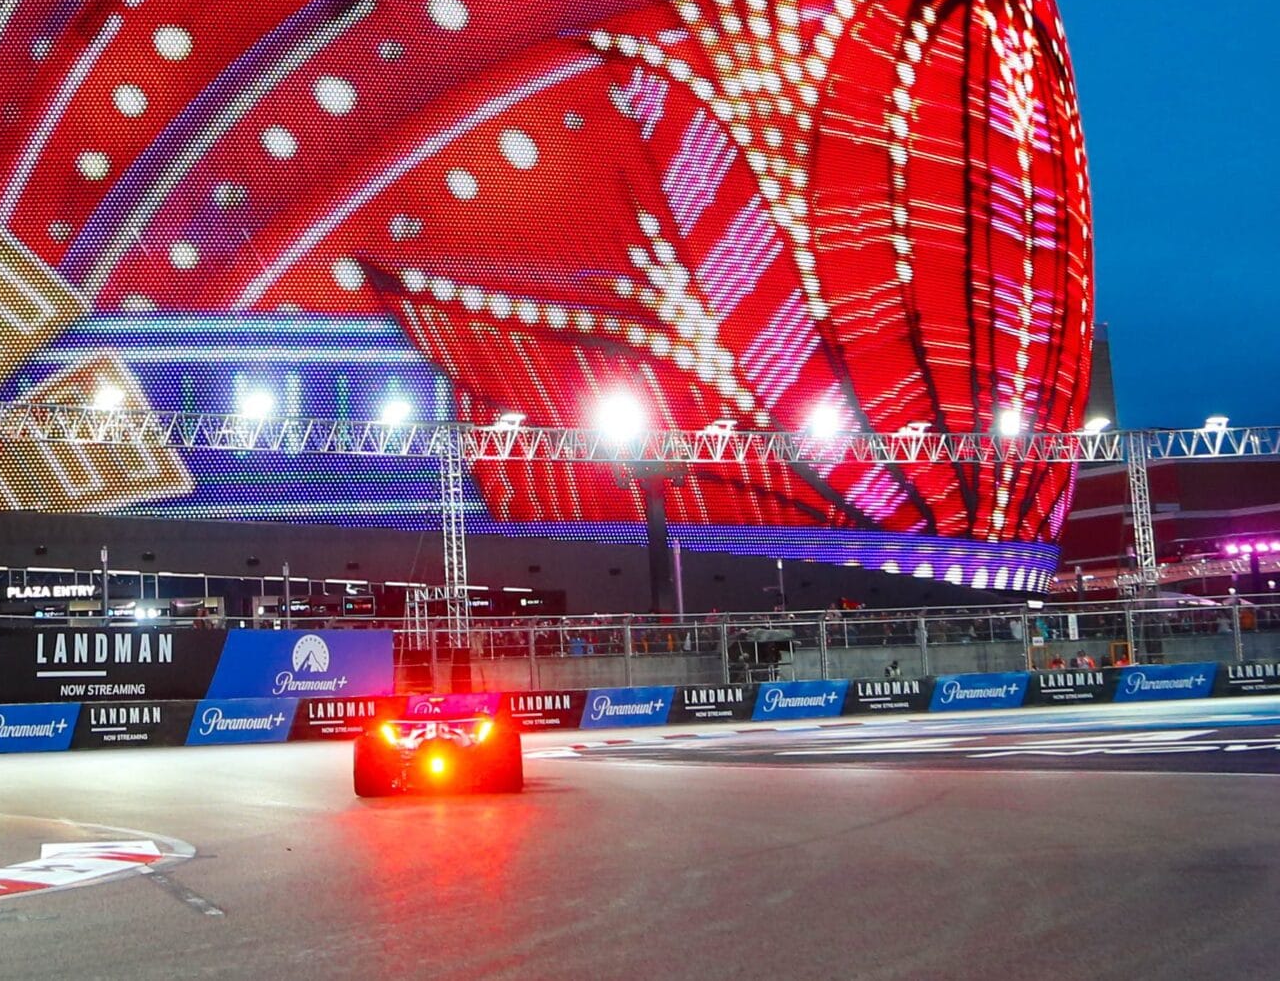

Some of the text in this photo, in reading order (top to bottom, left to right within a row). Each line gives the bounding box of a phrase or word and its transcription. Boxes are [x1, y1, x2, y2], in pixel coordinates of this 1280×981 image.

[7, 585, 95, 598] PLAZA ENTRY
[37, 633, 172, 664] LANDMAN
[272, 671, 348, 695] Paramount+
[858, 681, 920, 696] LANDMAN
[1039, 672, 1103, 688] LANDMAN
[1125, 672, 1206, 694] Paramount+
[60, 684, 145, 696] NOW STREAMING
[684, 688, 743, 704] LANDMAN
[941, 681, 1018, 704] Paramount+
[510, 695, 570, 711] LANDMAN
[591, 695, 664, 720] Paramount+
[763, 688, 838, 712] Paramount+
[91, 707, 161, 725] LANDMAN
[309, 702, 375, 718] LANDMAN
[199, 707, 285, 735] Paramount+
